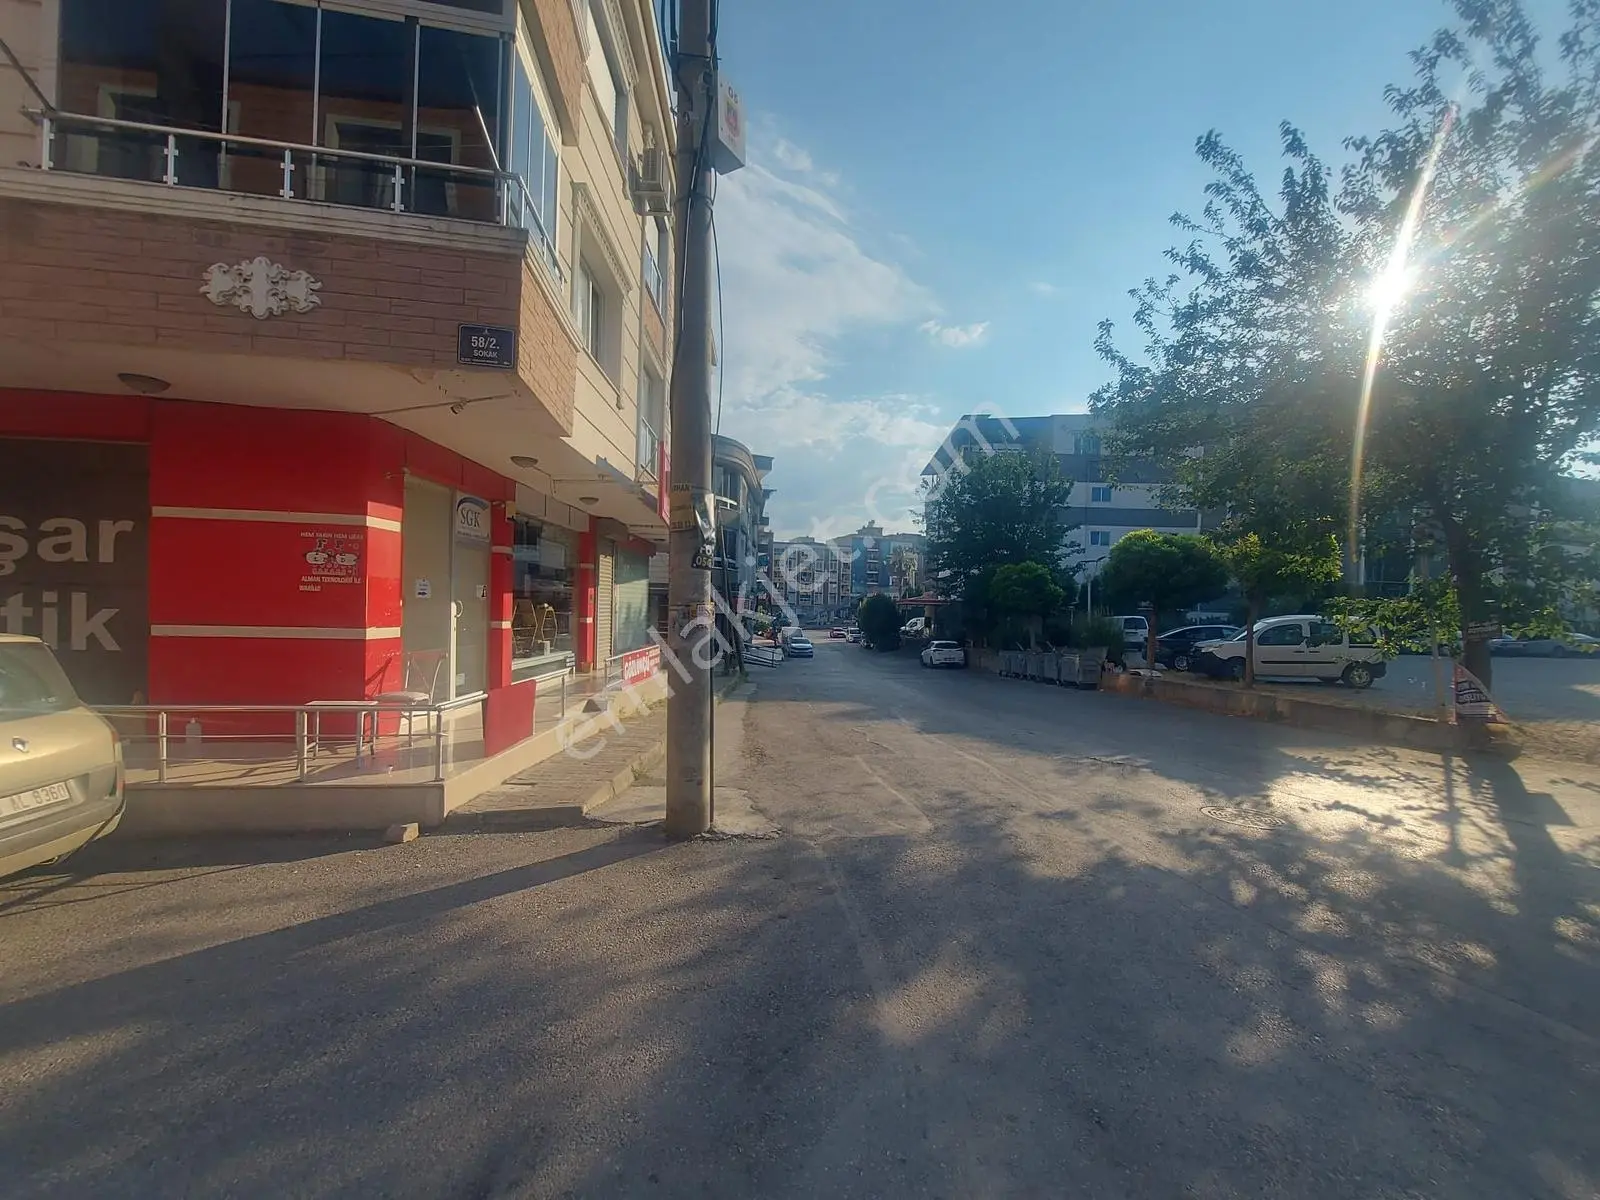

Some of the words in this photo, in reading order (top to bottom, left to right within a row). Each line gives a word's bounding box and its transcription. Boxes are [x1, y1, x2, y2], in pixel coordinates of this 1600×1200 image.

[471, 336, 500, 349] 58/2.
[473, 349, 498, 358] SOKAK
[460, 507, 480, 528] SGK
[0, 515, 135, 576] şar
[301, 575, 321, 583] ALMAN
[0, 592, 121, 651] tik
[32, 784, 67, 804] 8360
